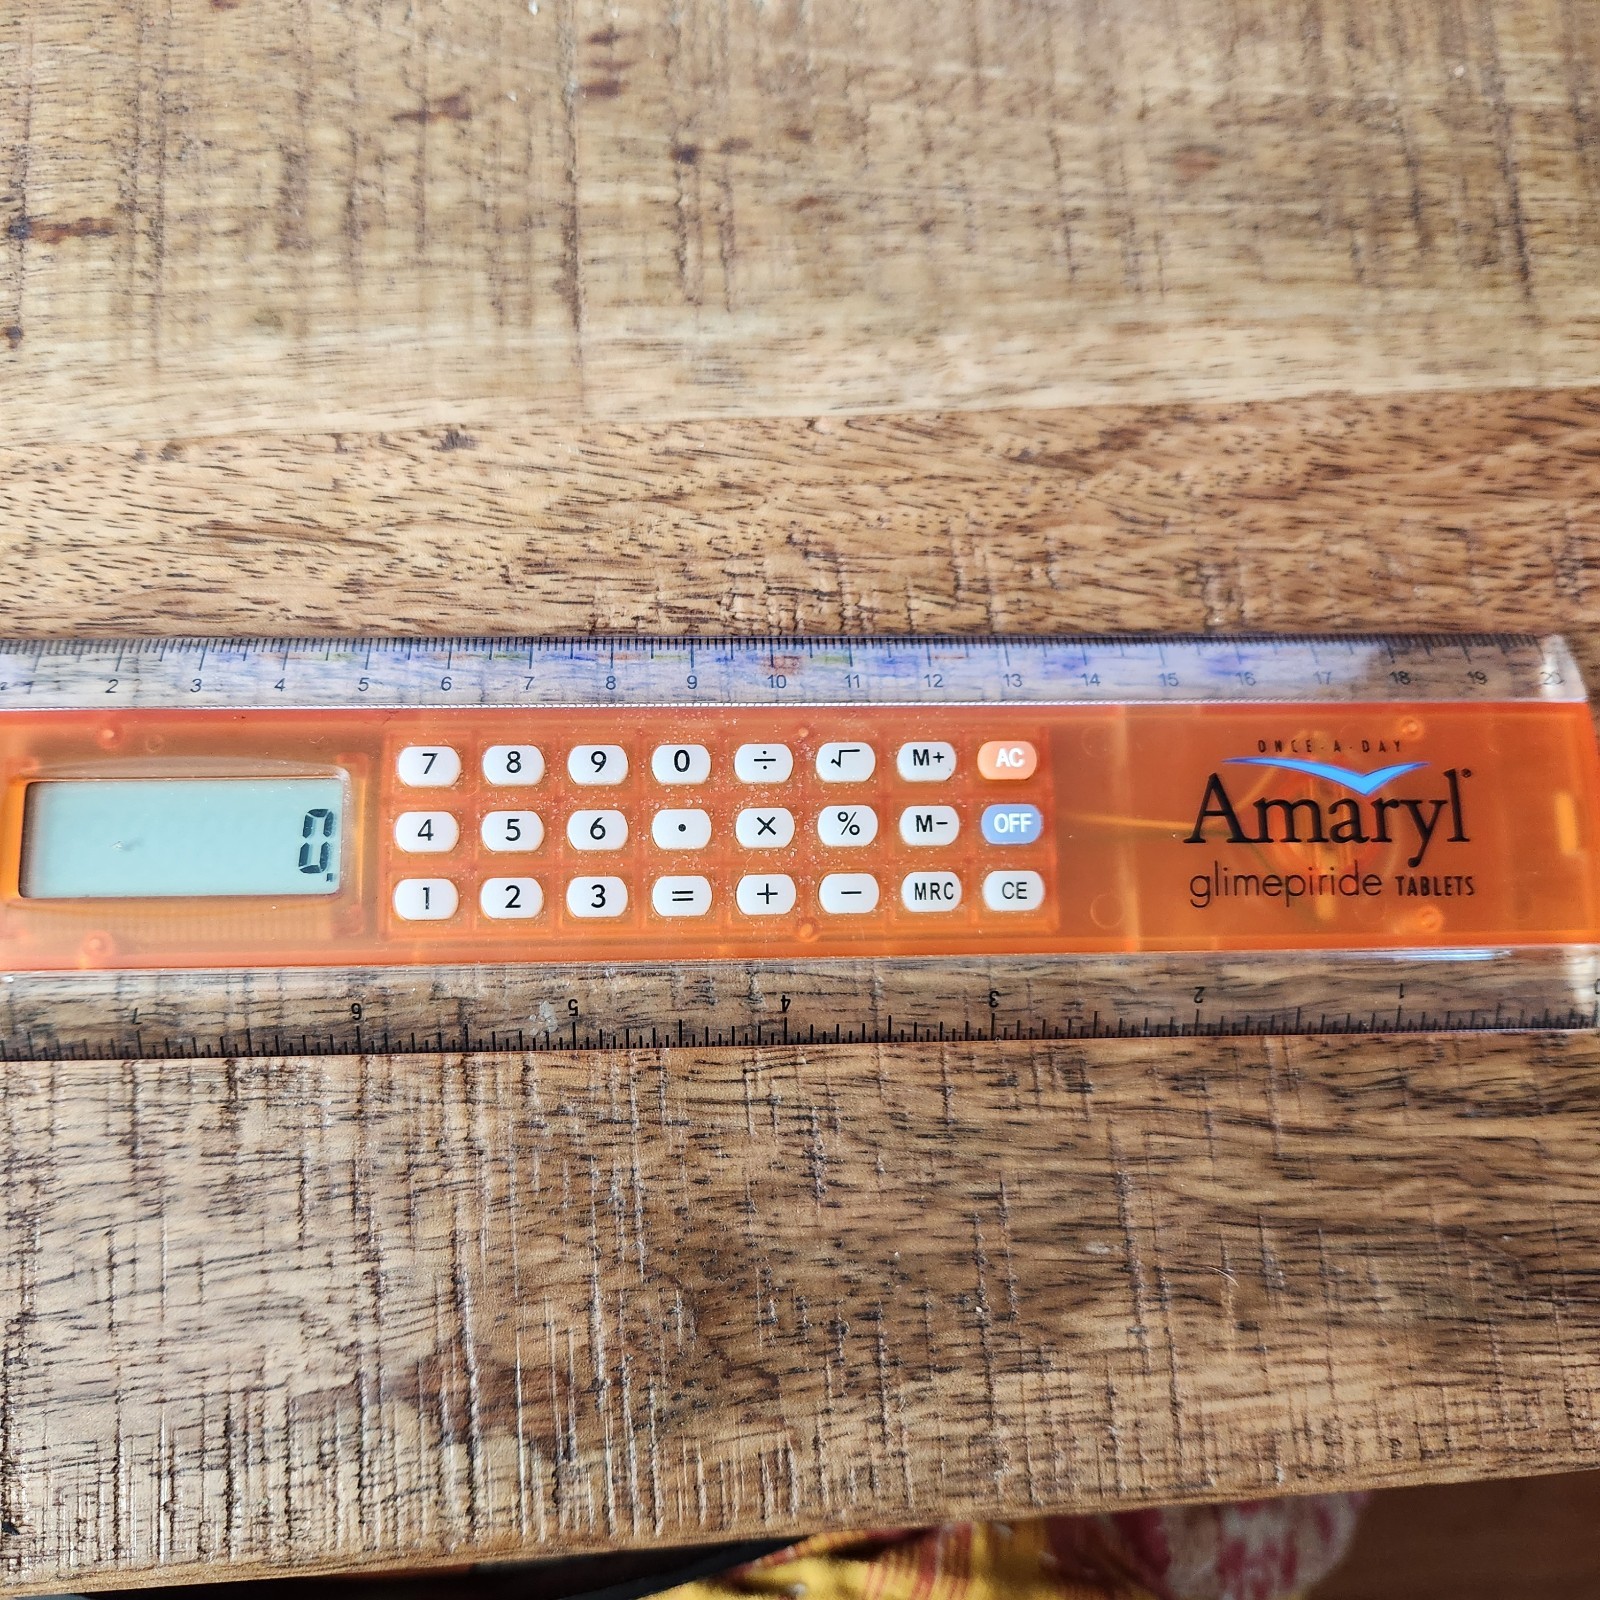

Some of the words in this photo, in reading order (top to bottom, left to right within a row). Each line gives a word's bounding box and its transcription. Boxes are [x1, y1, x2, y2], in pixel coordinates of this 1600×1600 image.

[105, 679, 118, 693] 2
[190, 678, 202, 693] 3
[274, 678, 286, 692] 4
[358, 678, 369, 692] 5
[440, 675, 452, 690] 6
[525, 676, 535, 690] 7
[605, 676, 616, 690] 8
[687, 676, 698, 690] 9
[768, 675, 787, 689] 10
[844, 674, 860, 688] 11
[924, 674, 943, 688] 12
[1004, 674, 1022, 688] 13
[1082, 674, 1100, 688] 14
[1159, 673, 1178, 687] 15
[1236, 672, 1256, 686] 16
[1314, 672, 1332, 685] 17
[1390, 670, 1411, 685] 18
[1467, 670, 1487, 685] 19
[422, 753, 438, 775] 7
[506, 750, 522, 774] 8
[590, 750, 607, 773] 9
[673, 749, 690, 773] 0
[912, 749, 945, 767] M+
[995, 748, 1025, 768] AC
[417, 819, 434, 842] 4
[505, 818, 521, 841] 5
[589, 817, 606, 840] 6
[993, 812, 1033, 834] OFF
[913, 881, 955, 901] MRC
[1001, 881, 1028, 900] CE
[1189, 860, 1382, 908] glimepiride
[1395, 875, 1475, 897] TABLETS
[422, 886, 430, 910] 1
[505, 884, 521, 909] 2
[591, 884, 606, 909] 3
[988, 991, 999, 1009] 3
[1194, 986, 1205, 1004] 2
[1398, 983, 1405, 999] 1
[350, 1003, 362, 1021] 6
[568, 998, 578, 1017] 5
[781, 994, 792, 1014] 4
[131, 1007, 142, 1025] 7
